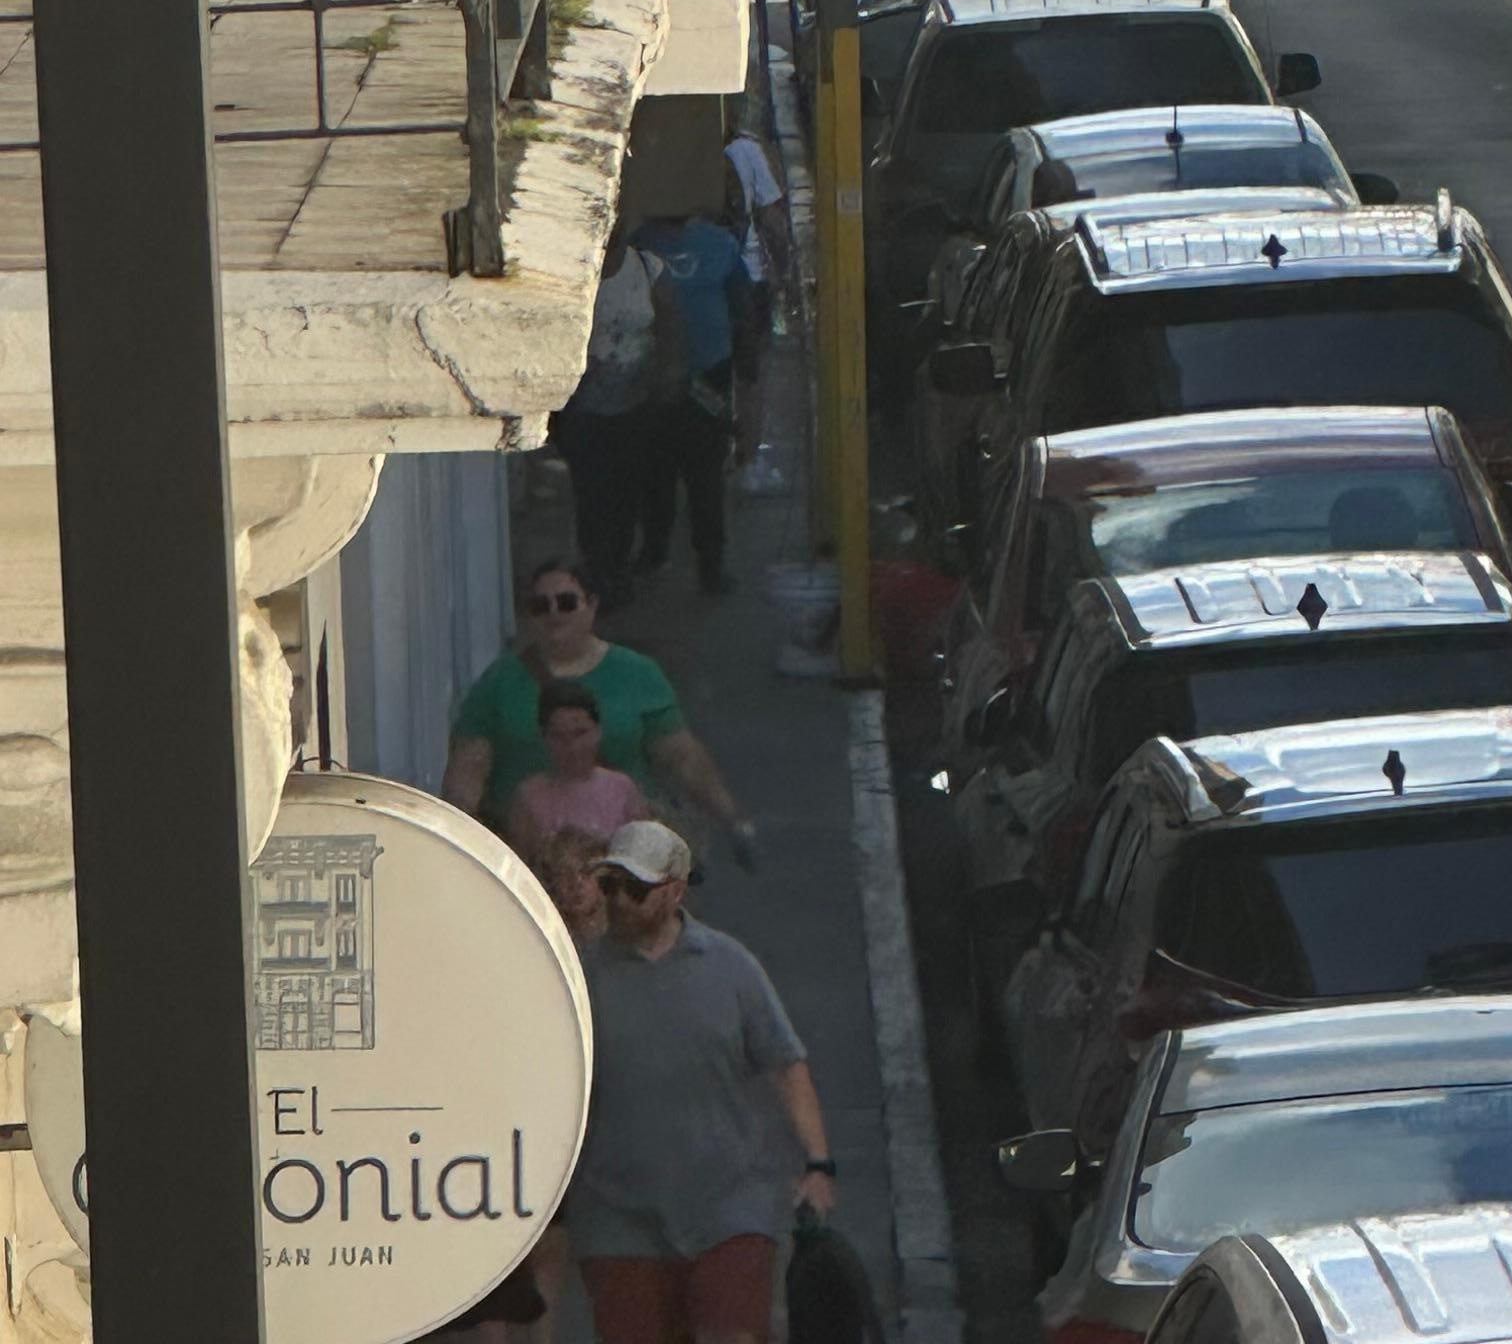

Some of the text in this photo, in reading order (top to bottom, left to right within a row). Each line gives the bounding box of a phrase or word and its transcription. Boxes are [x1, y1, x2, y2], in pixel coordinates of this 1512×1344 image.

[266, 1085, 324, 1136] El
[72, 1127, 534, 1224] onial
[262, 1245, 393, 1268] SAN JUAN
